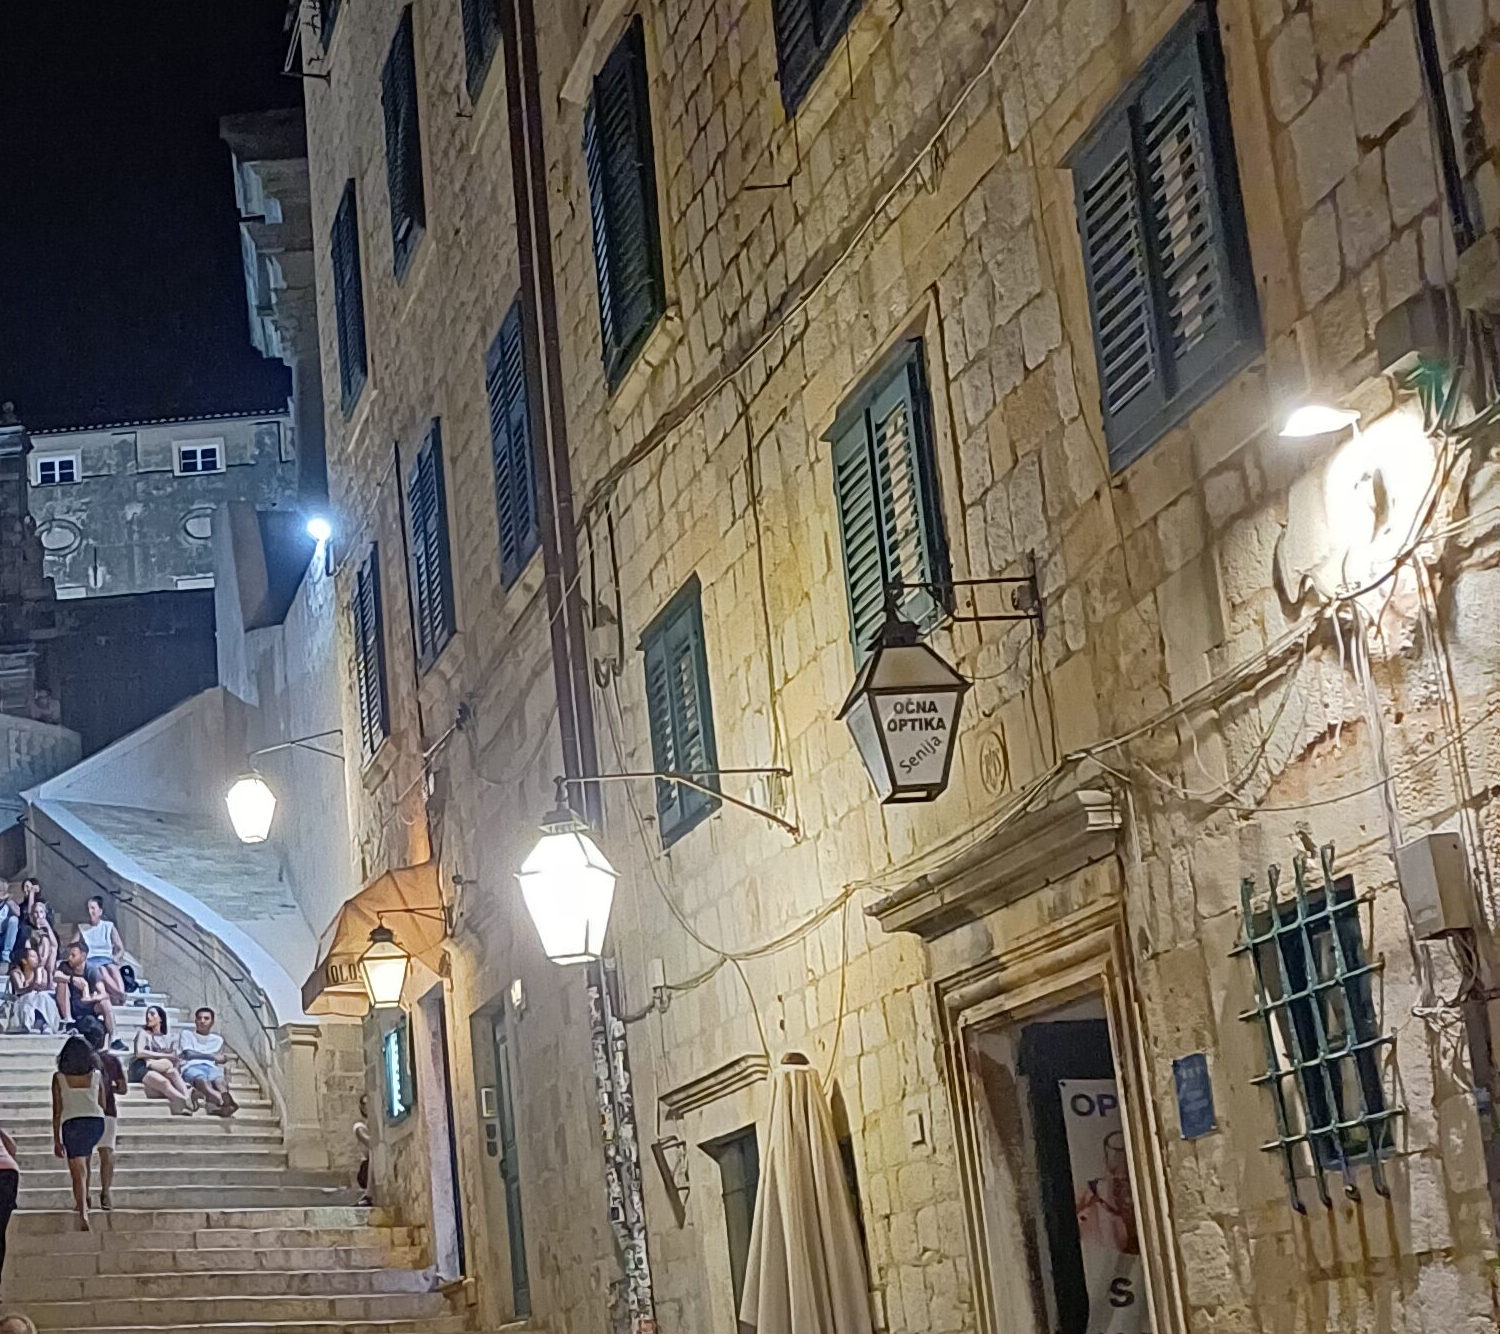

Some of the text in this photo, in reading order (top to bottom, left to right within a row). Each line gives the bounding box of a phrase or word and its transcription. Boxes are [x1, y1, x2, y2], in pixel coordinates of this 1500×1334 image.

[894, 698, 938, 714] OČNA
[887, 717, 946, 732] OPTIKA
[899, 736, 942, 774] Senija
